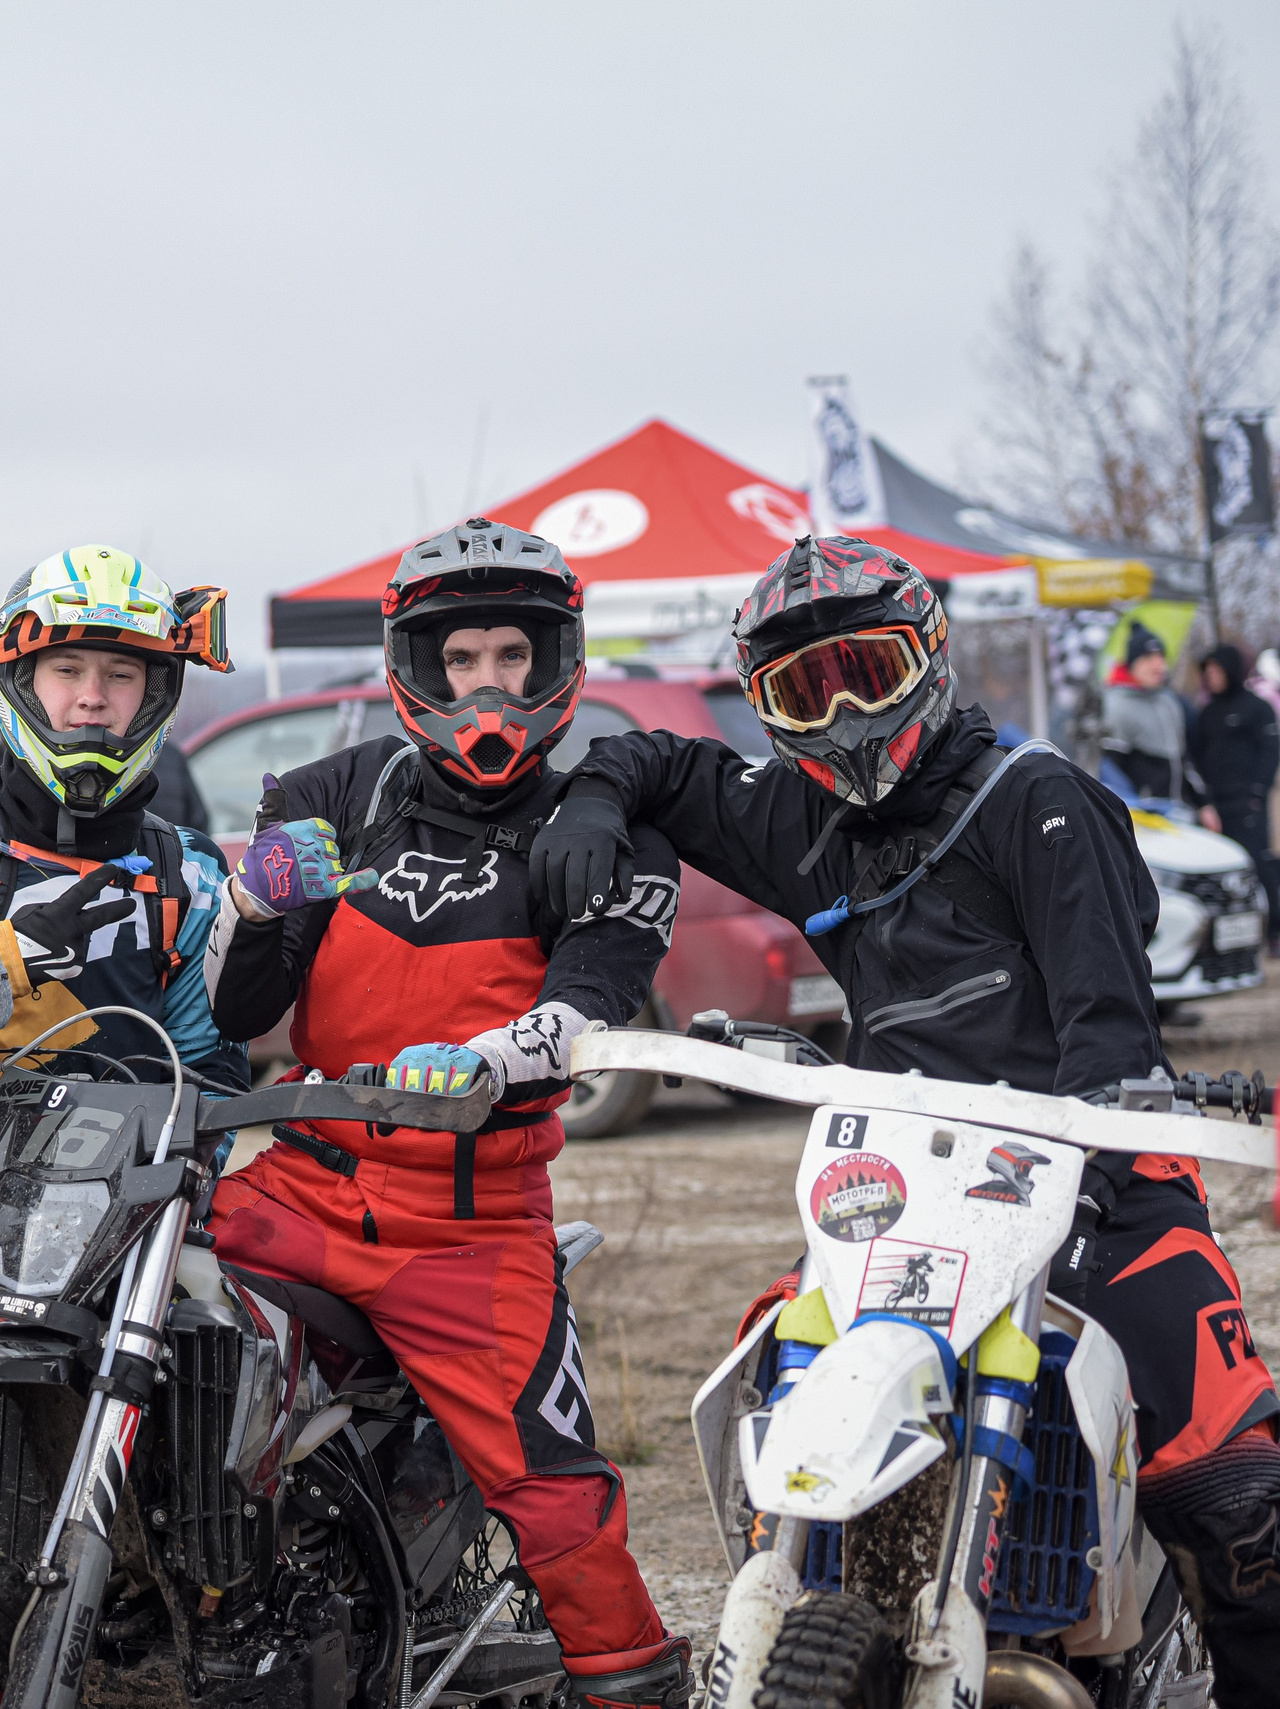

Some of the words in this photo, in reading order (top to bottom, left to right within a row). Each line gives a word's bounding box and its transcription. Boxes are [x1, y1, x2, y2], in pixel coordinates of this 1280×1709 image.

[77, 607, 139, 627] HIZER
[1041, 815, 1066, 835] ASRV
[47, 1085, 68, 1109] 9
[837, 1116, 858, 1147] 8
[1069, 1235, 1086, 1271] SPORT
[0, 1295, 11, 1305] NO
[10, 1295, 35, 1310] LIMITS
